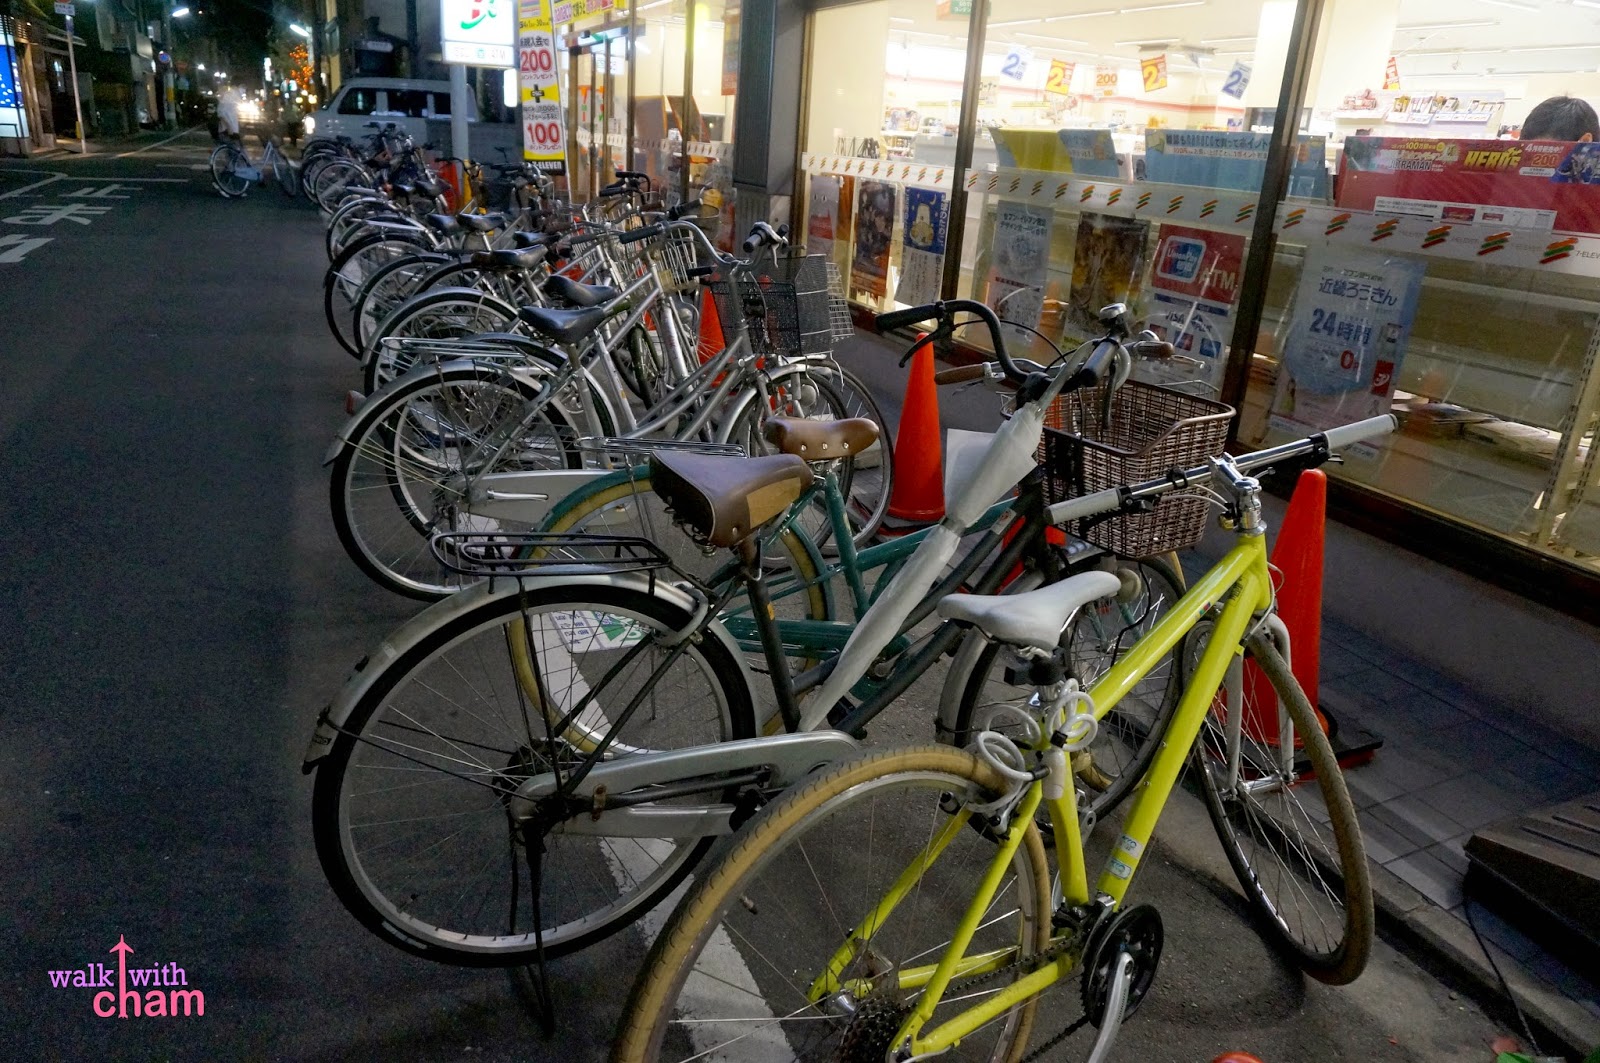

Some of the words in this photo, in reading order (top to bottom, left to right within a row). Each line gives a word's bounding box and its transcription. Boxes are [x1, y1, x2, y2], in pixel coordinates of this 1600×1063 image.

[521, 50, 552, 72] 200
[1001, 53, 1020, 77] 2
[1096, 74, 1118, 86] 200
[1222, 70, 1242, 96] 2
[528, 122, 560, 144] 100
[1198, 267, 1237, 291] ATM
[1318, 276, 1398, 307] 近畿ろうきん
[1309, 308, 1373, 345] 24時間
